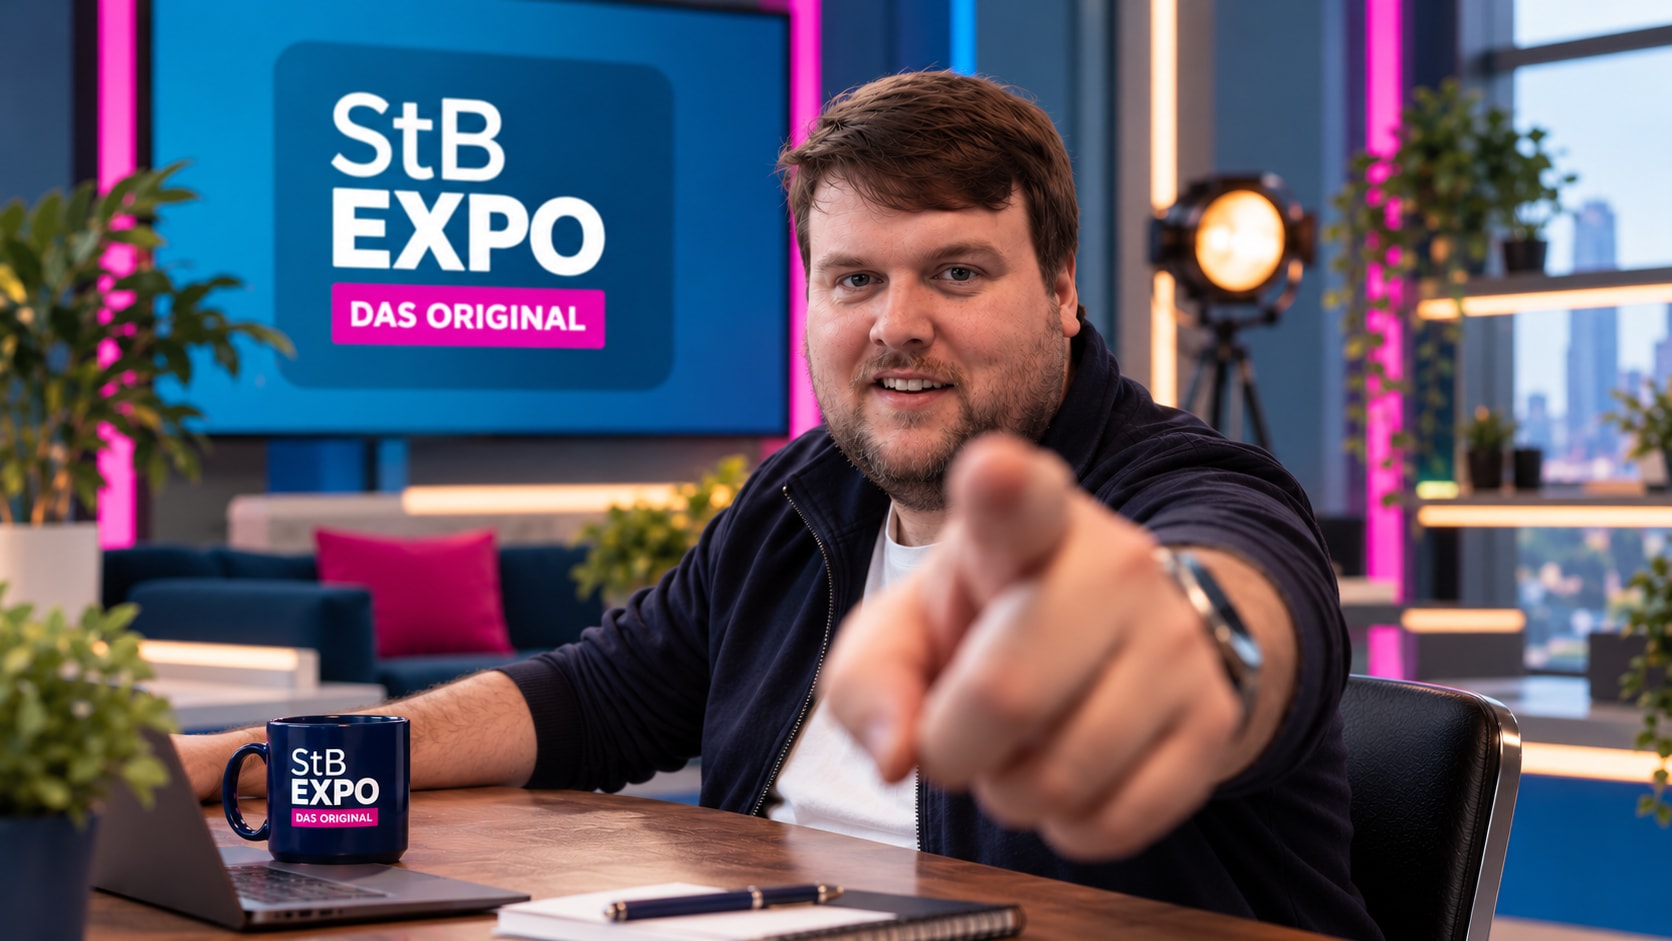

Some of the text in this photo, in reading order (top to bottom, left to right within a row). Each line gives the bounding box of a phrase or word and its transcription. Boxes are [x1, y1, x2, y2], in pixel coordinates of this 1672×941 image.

[330, 91, 506, 182] StB
[332, 187, 606, 277] EXPO
[350, 300, 586, 331] DAS ORIGINAL
[291, 747, 347, 777] StB
[291, 777, 380, 806] EXPO
[295, 813, 373, 824] DAS ORIGINAL
